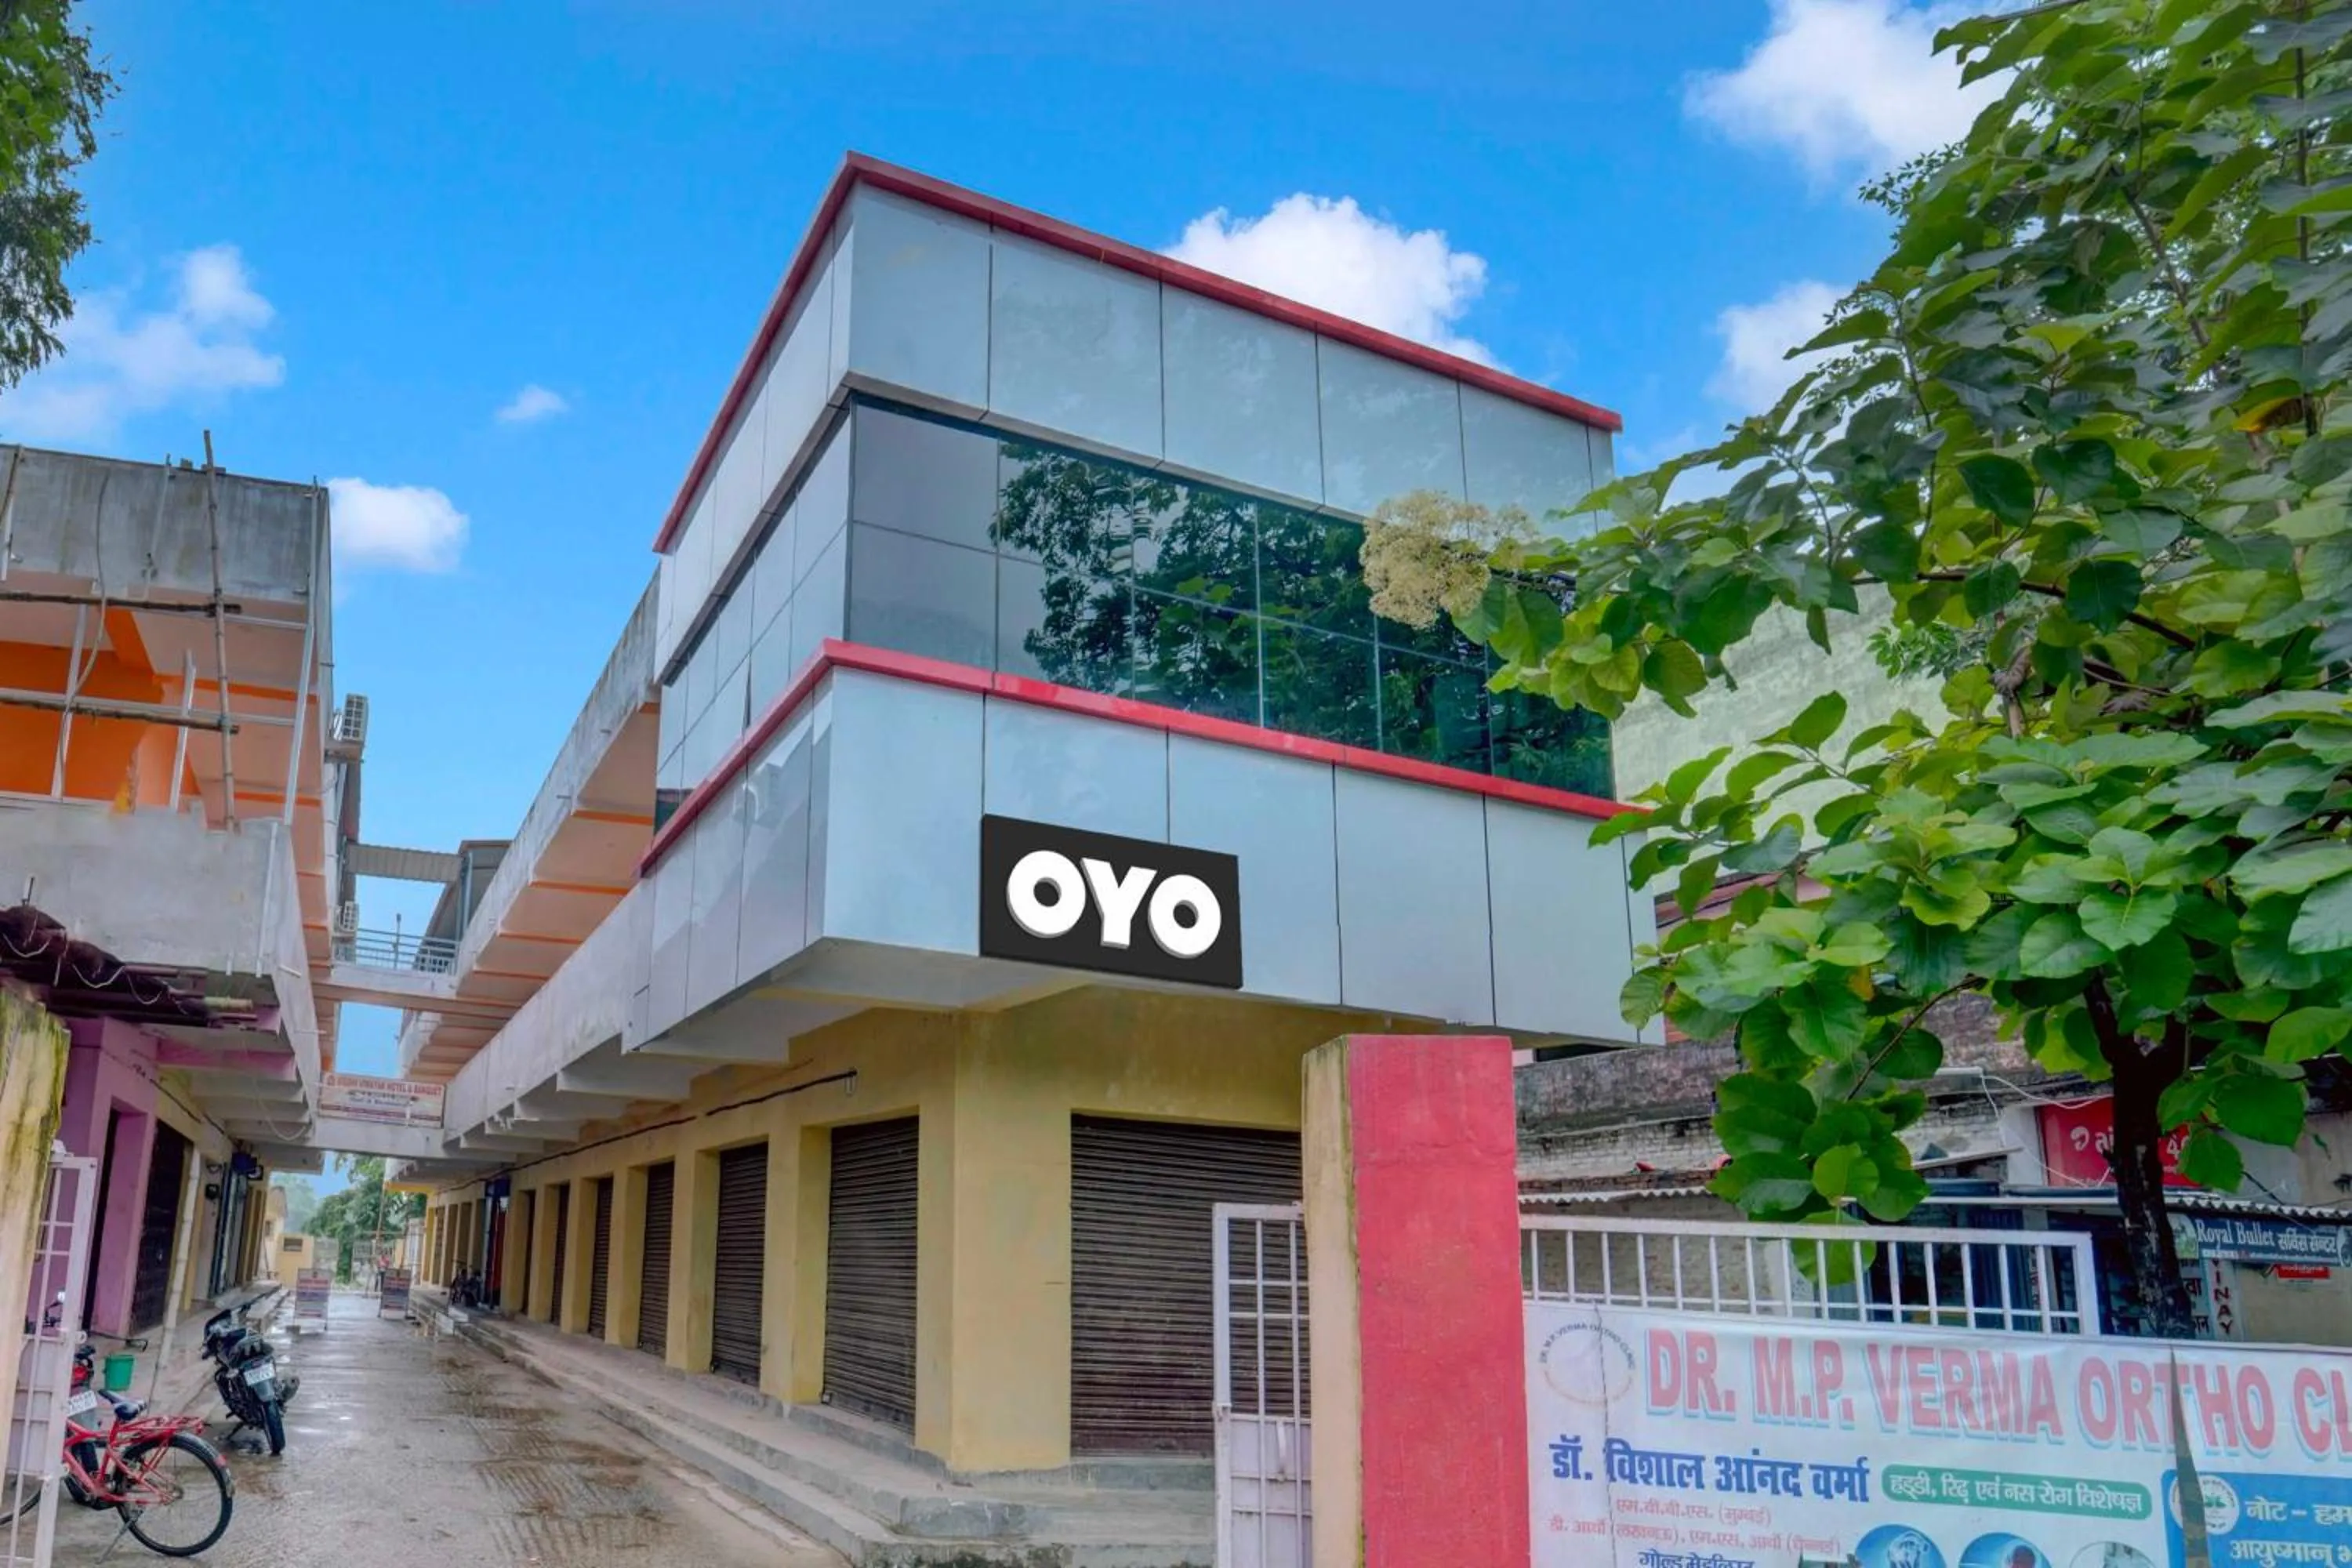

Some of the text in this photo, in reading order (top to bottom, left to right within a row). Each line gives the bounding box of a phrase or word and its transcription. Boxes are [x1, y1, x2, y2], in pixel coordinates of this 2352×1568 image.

[1006, 851, 1221, 959] OYO
[2195, 1219, 2233, 1250] Royal
[2236, 1221, 2275, 1246] Bullet
[1646, 1329, 1736, 1421] DR.
[1751, 1336, 1855, 1429] M.P.
[1865, 1343, 2064, 1446] VERMA
[2075, 1356, 2274, 1457] ORTHO
[1549, 1435, 1592, 1479] डॉ.
[1604, 1437, 1706, 1489] विशाल
[1809, 1456, 1869, 1503] वर्मा
[1975, 1475, 2001, 1501] एवं
[2002, 1482, 2035, 1504] नस
[2039, 1480, 2072, 1506] रोग
[2076, 1482, 2143, 1512] विशेषज्ञ
[2245, 1496, 2287, 1521] नोट
